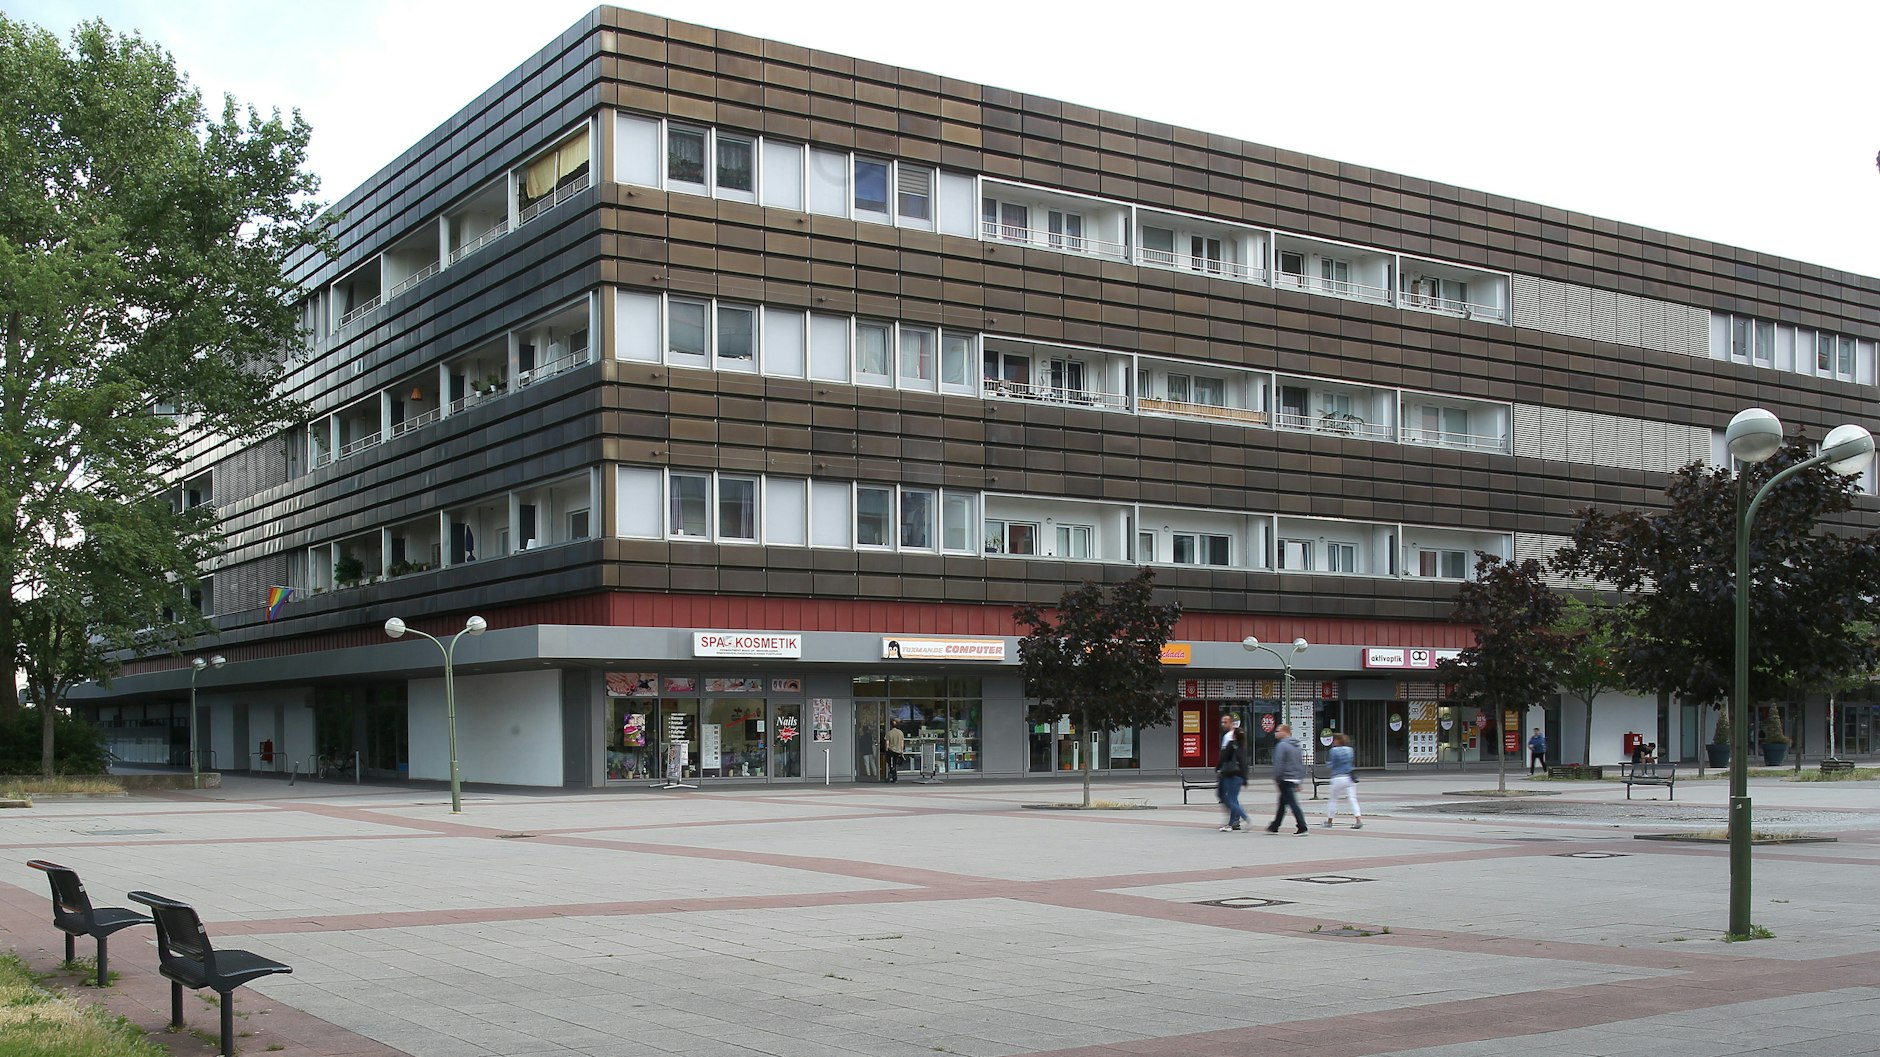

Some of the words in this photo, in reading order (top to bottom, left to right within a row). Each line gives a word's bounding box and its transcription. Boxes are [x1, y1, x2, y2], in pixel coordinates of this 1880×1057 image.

[701, 636, 725, 648] SPA
[735, 637, 797, 649] KOSMETIK
[945, 645, 1003, 654] COMPUTER
[1371, 655, 1402, 663] aktivoptik
[776, 716, 798, 726] Nails
